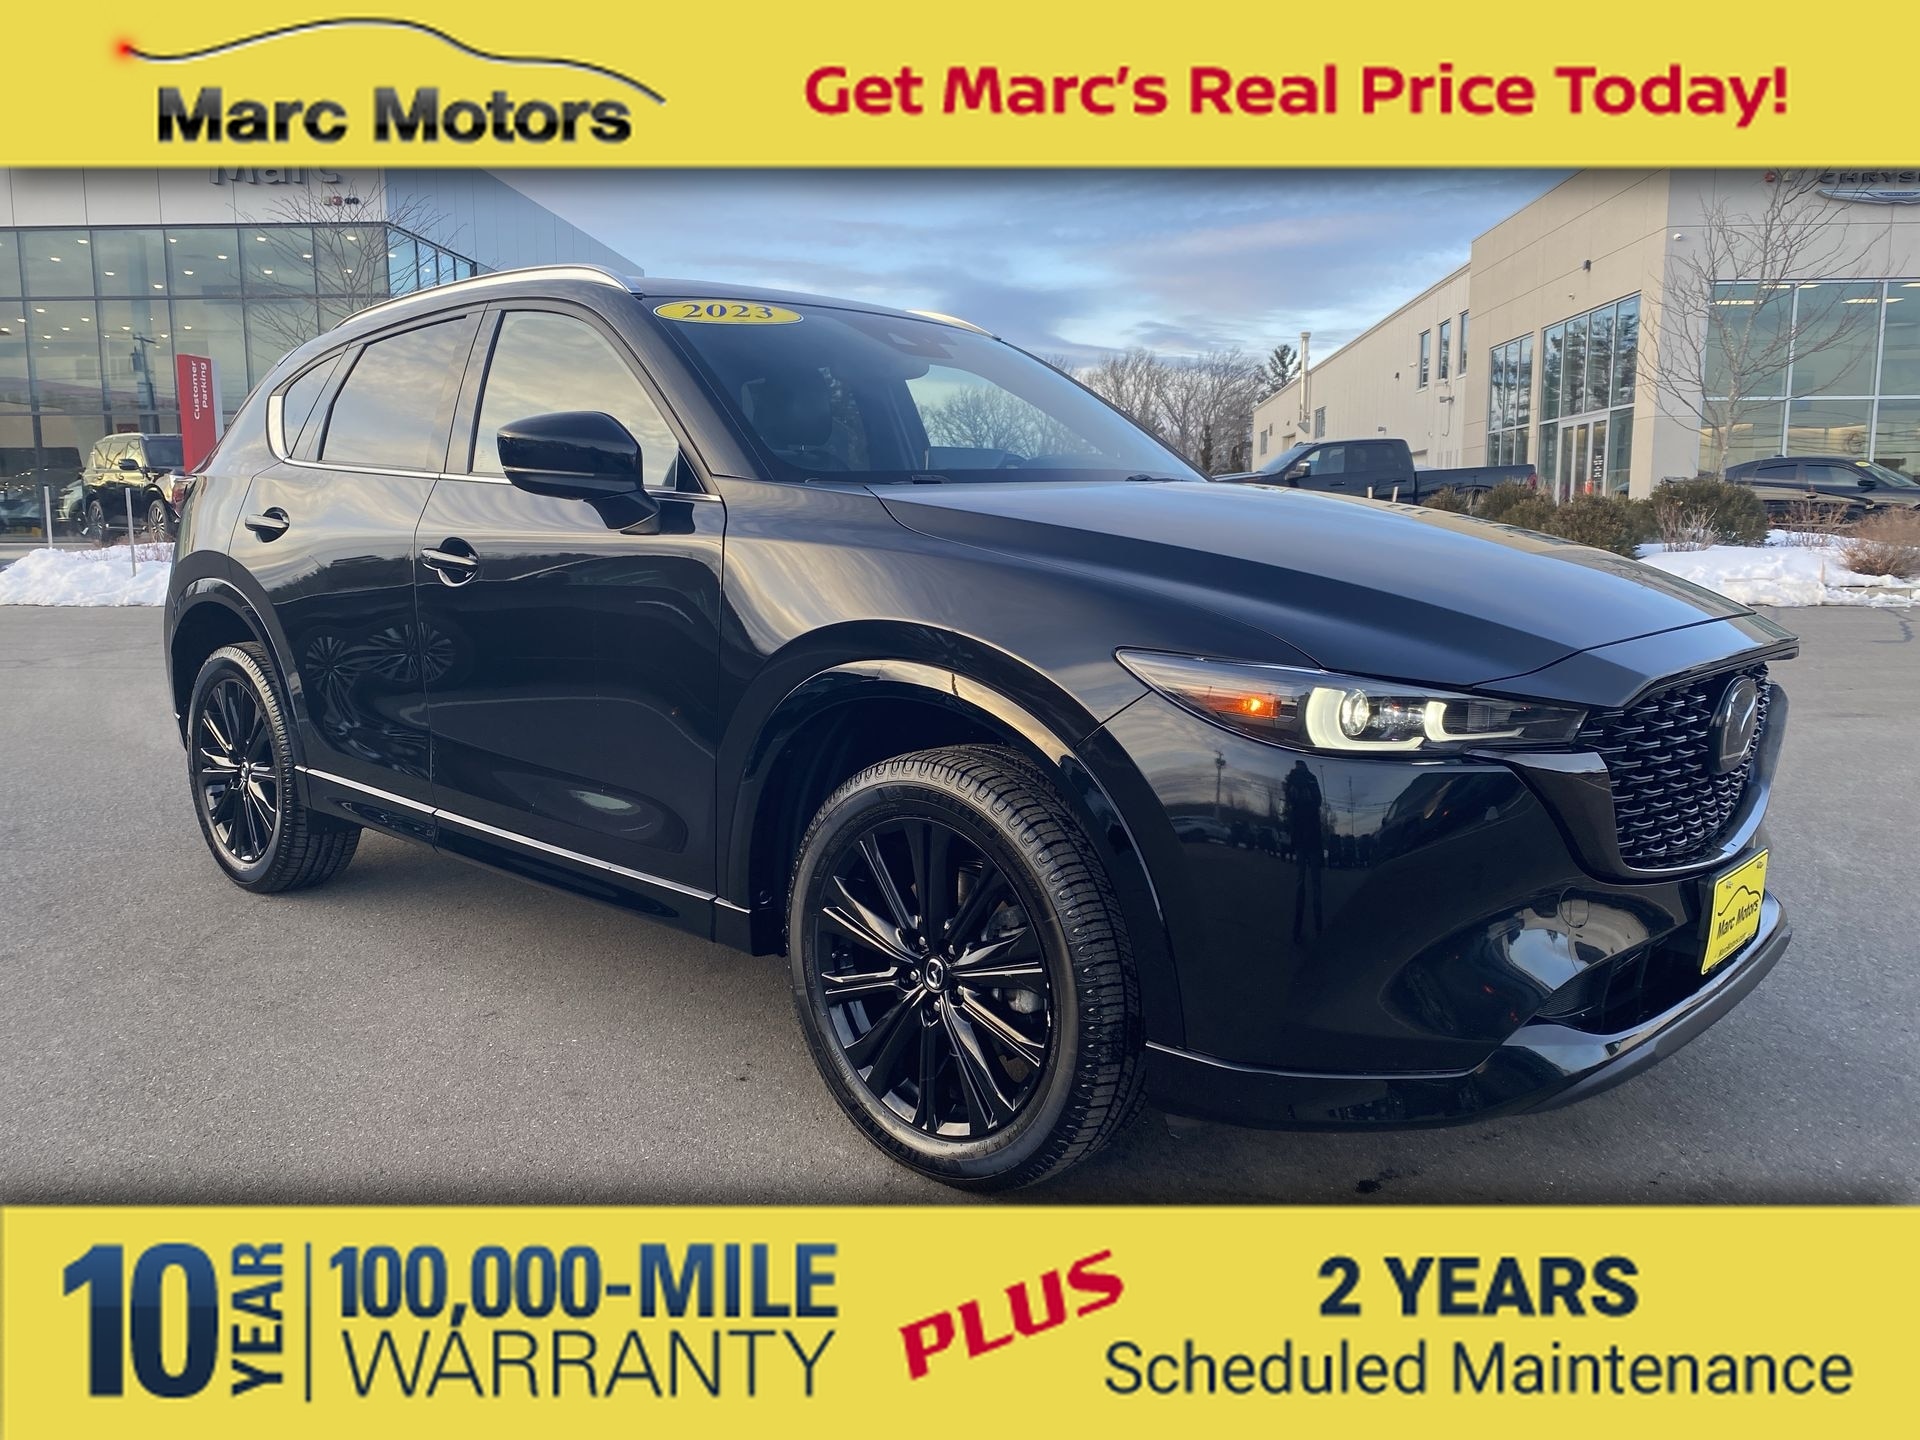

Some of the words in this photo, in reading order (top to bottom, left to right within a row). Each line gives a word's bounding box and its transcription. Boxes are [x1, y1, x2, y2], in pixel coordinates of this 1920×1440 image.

[1820, 171, 1920, 184] CHRYS
[682, 304, 773, 319] 2023
[192, 360, 200, 420] Customer
[200, 362, 208, 408] Parking
[1717, 916, 1735, 939] Marc
[1736, 900, 1759, 925] Motors
